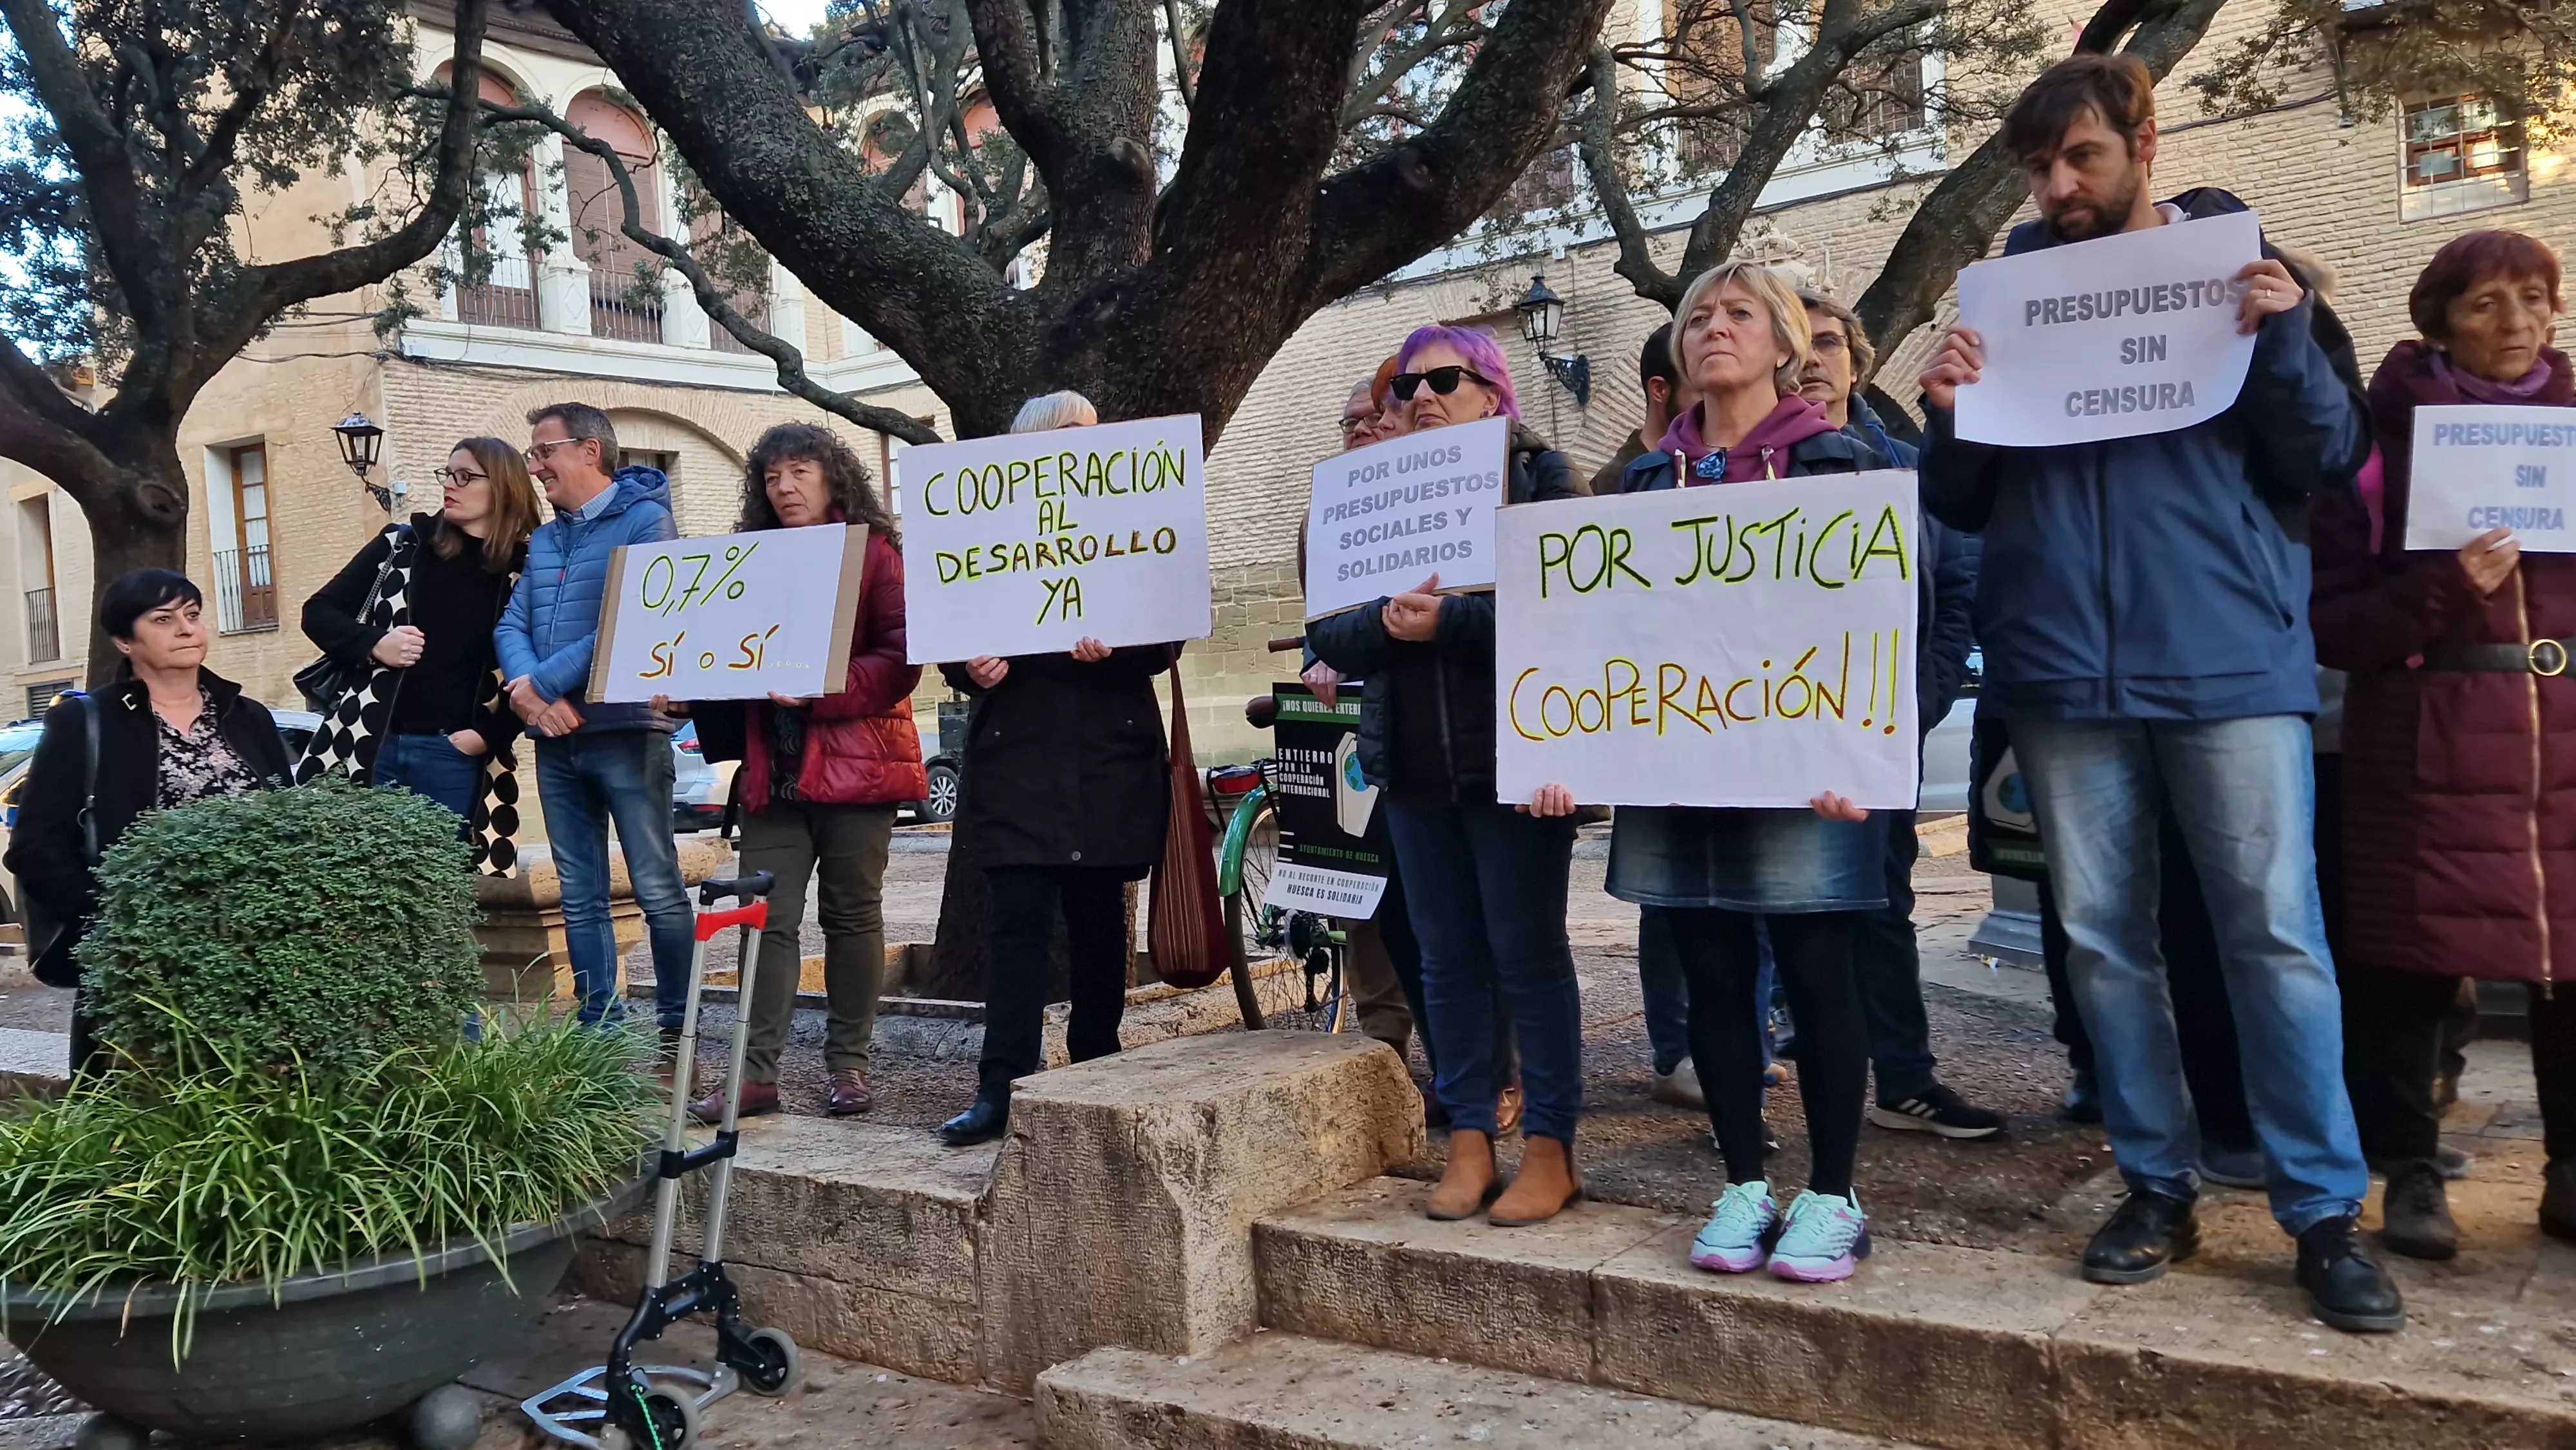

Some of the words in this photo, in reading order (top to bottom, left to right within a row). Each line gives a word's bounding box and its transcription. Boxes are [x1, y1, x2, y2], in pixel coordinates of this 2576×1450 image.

[2119, 334, 2167, 365] SIN
[2065, 381, 2195, 417] CENSURA
[2433, 422, 2576, 447] PRESUPUEST
[924, 440, 1186, 516] COOPERACIÓN
[1348, 461, 1390, 487] POR
[1396, 445, 1462, 474] UNOS
[2515, 464, 2546, 487] SIN
[1322, 471, 1499, 525] PRESUPUESTOS
[1037, 499, 1079, 536] AL
[1339, 511, 1448, 551] SOCIALES
[1455, 507, 1473, 526] Y
[2467, 506, 2565, 531] CENSURA
[935, 527, 1177, 584] DESARROLLO
[1337, 540, 1473, 581] SOLIDARIOS
[1539, 523, 1653, 599] POR
[1671, 504, 1912, 590] JUSTICIA
[641, 541, 760, 618] 0,7%
[1035, 575, 1083, 625] YA
[638, 630, 687, 679] SÍ
[1278, 748, 1332, 764] ENTIERRO
[1279, 762, 1294, 772] POR
[1300, 763, 1311, 773] LA
[1279, 773, 1324, 786] COOPERACIÓN
[1280, 784, 1330, 797] INTERNACIONAL
[1299, 844, 1343, 858] AYUNTAMIENTO
[1345, 851, 1353, 860] DE
[1355, 852, 1379, 863] HUESCA
[1278, 869, 1286, 878] NO
[1289, 871, 1295, 880] AL
[1298, 872, 1325, 884] RECORTE
[1327, 876, 1334, 885] EN
[1337, 878, 1379, 892] COOPERACIÓN
[1287, 883, 1314, 897] HUESCA
[1316, 889, 1325, 899] ES
[1327, 890, 1363, 905] SOLIDARIA
